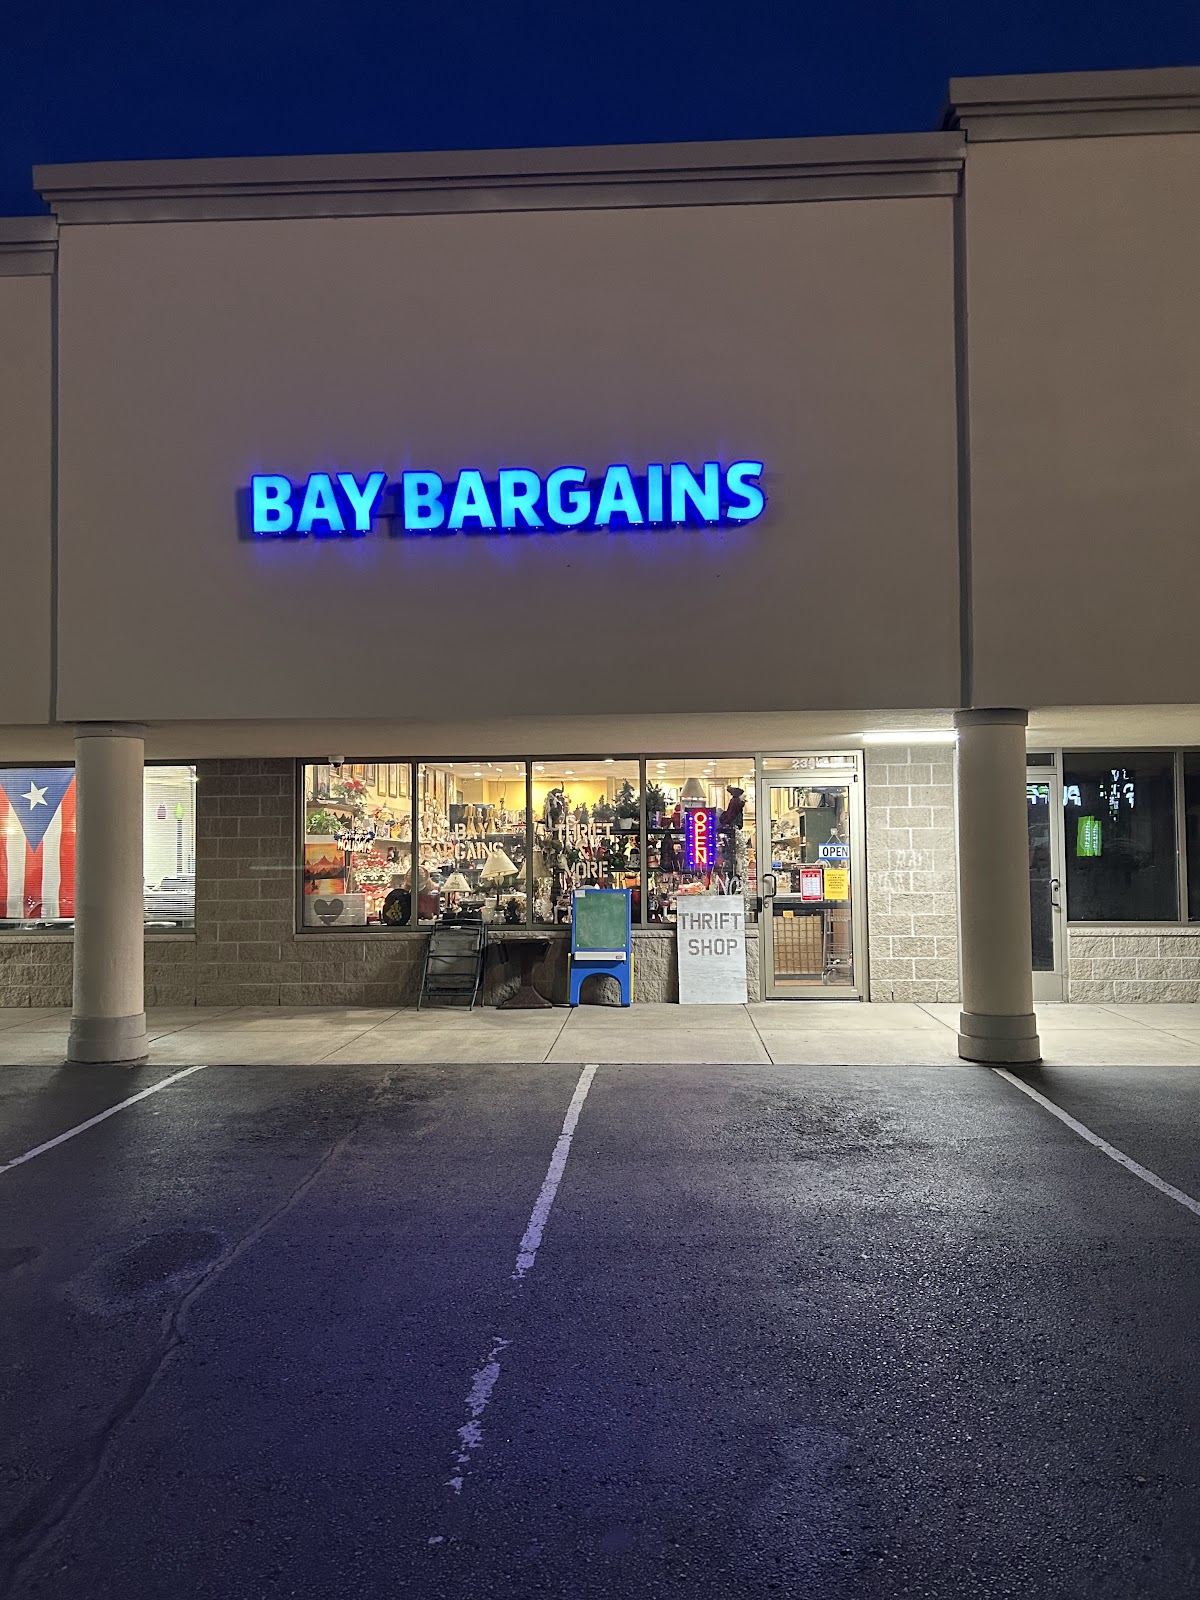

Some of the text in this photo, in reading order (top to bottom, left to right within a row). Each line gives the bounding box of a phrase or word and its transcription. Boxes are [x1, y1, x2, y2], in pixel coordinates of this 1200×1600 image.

[251, 461, 764, 534] BAY BARGAINS
[454, 823, 489, 840] BAY
[554, 822, 614, 842] THRIFT
[694, 811, 707, 864] OPEN
[420, 841, 504, 861] BARGAINS
[822, 846, 849, 857] OPEN
[564, 860, 609, 879] MORE
[678, 912, 742, 930] THRIFT
[688, 938, 738, 956] SHOP
